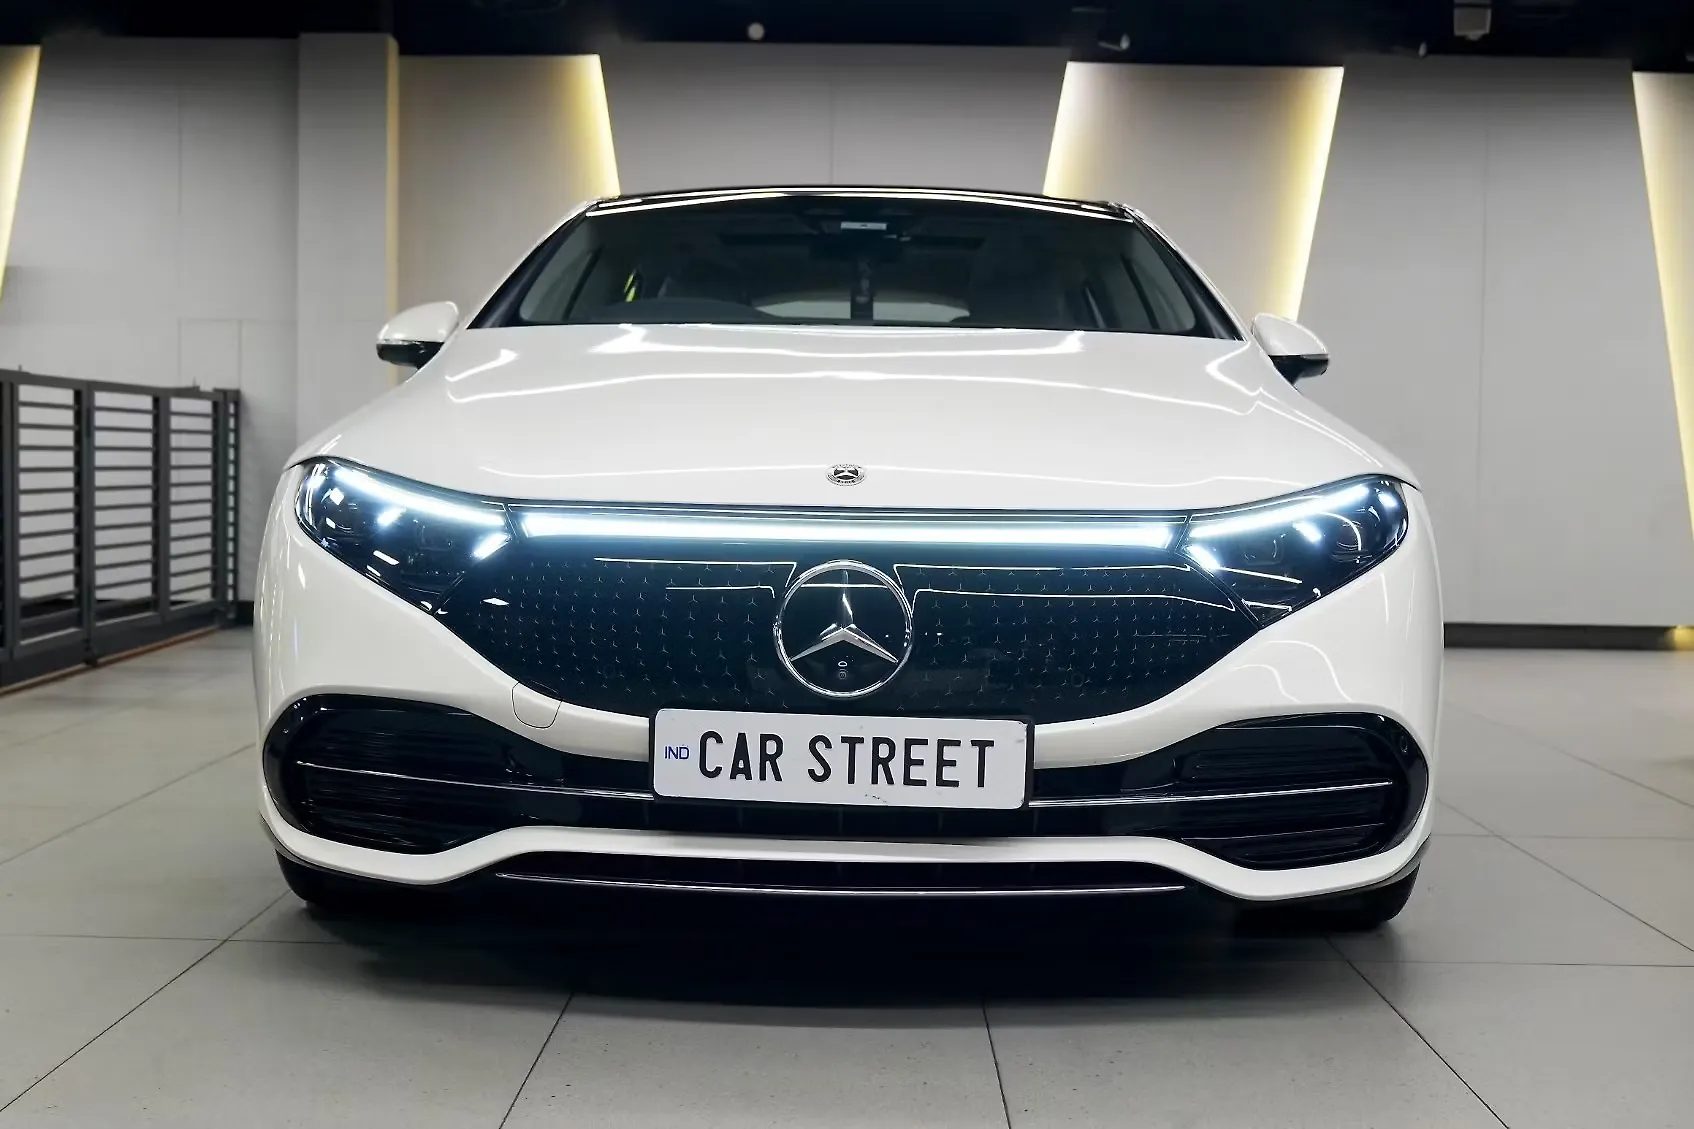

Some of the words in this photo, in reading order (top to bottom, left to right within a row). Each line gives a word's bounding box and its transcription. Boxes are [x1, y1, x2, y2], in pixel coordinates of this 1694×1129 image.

[664, 745, 690, 760] IND
[698, 730, 784, 782] CAR
[807, 734, 995, 788] STREET
